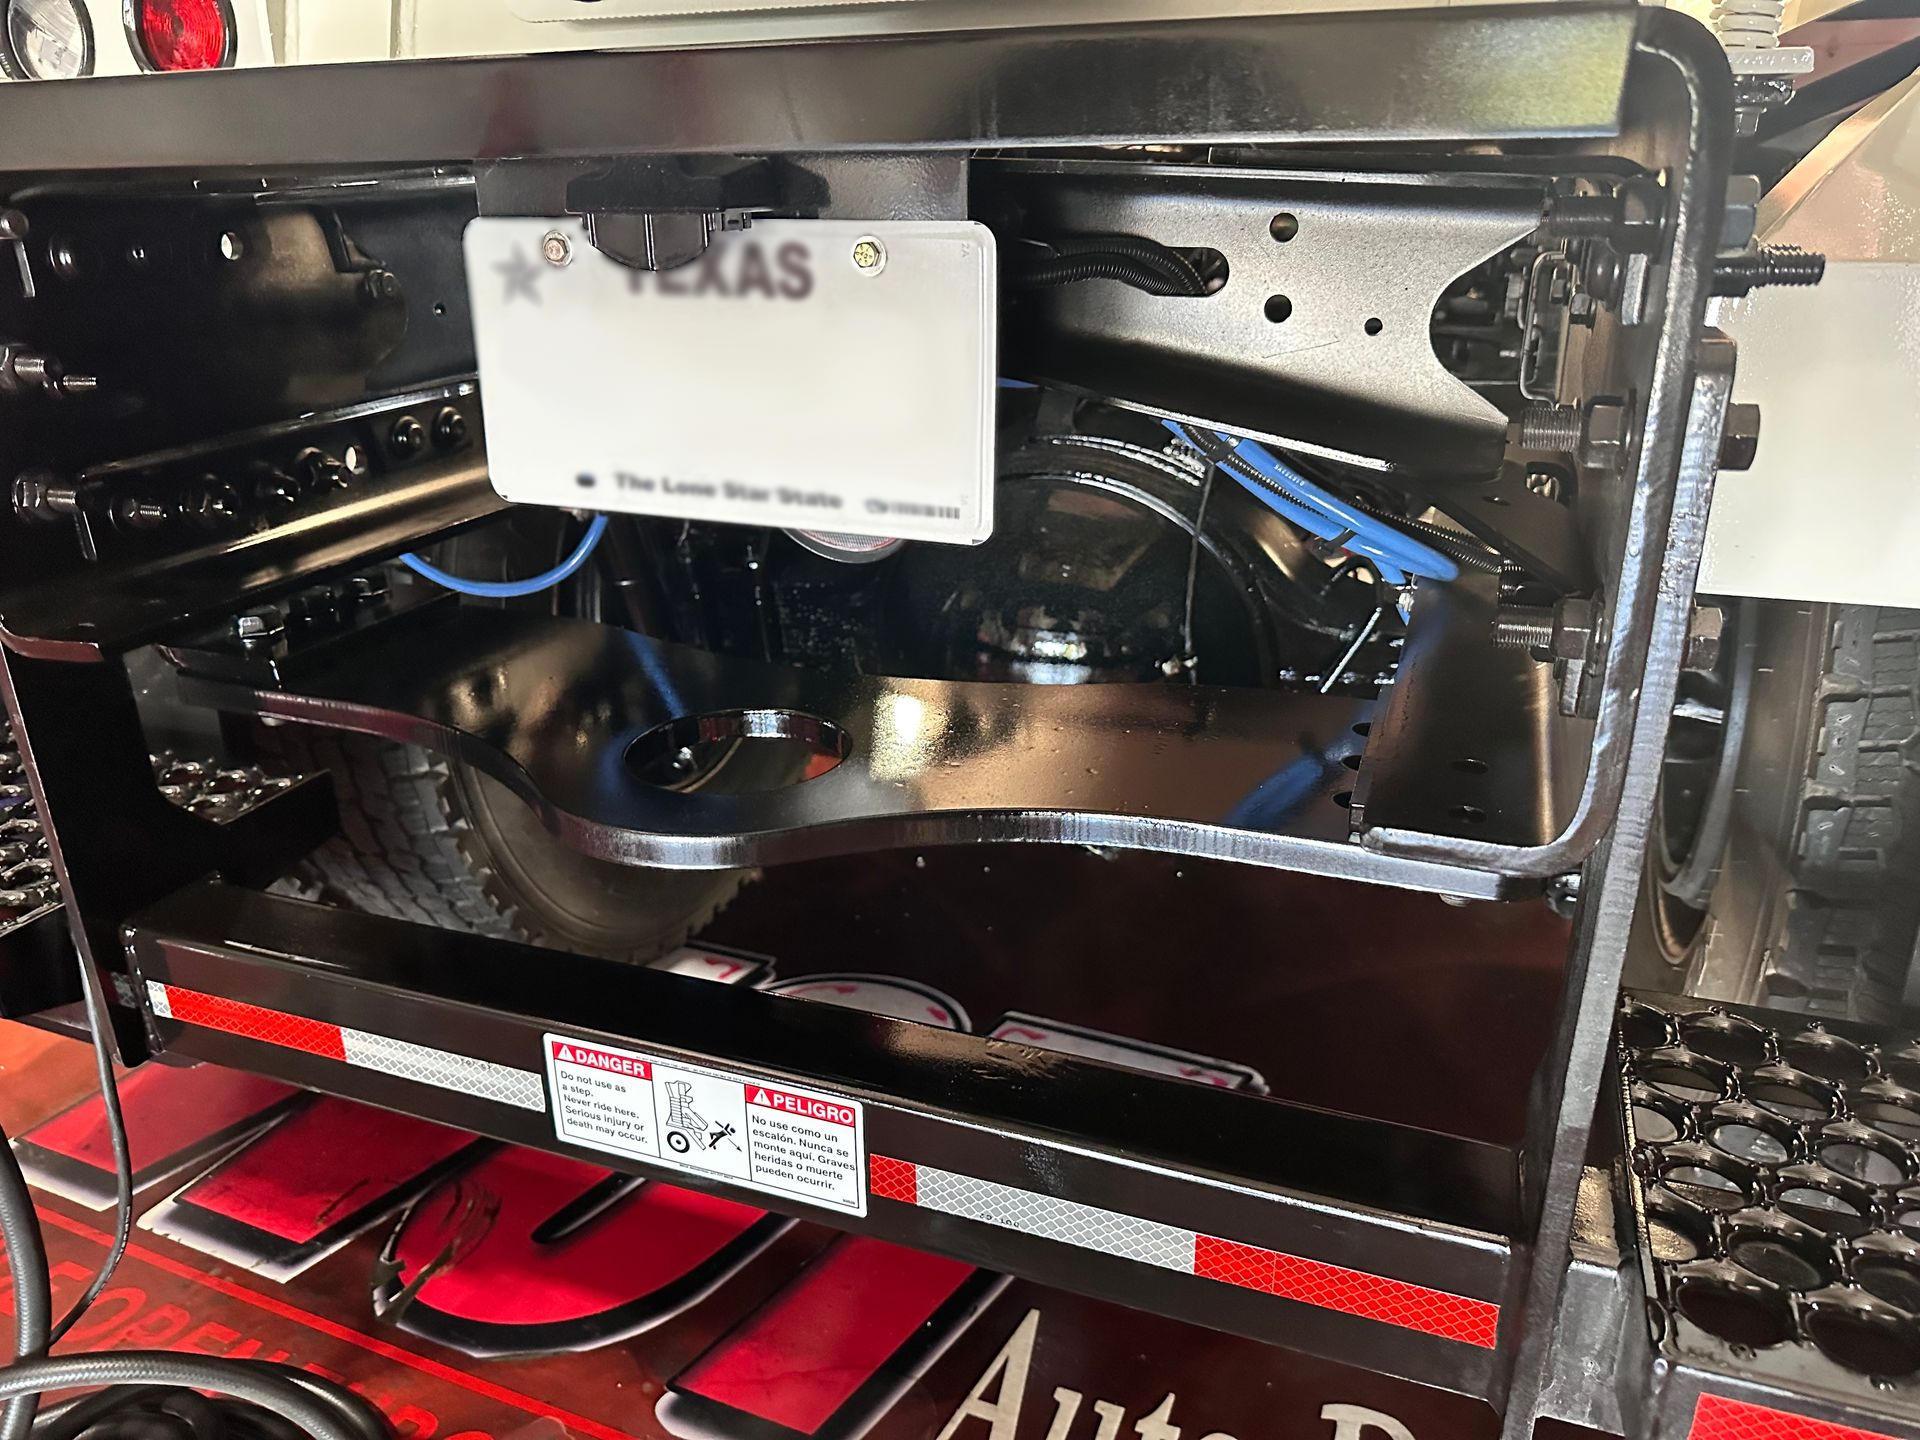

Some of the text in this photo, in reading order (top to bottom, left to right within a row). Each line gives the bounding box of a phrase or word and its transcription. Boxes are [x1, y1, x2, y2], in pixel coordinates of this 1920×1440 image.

[627, 237, 814, 300] XAS
[576, 1050, 644, 1077] DANGER
[561, 1071, 626, 1093] Do not use as
[571, 1085, 593, 1097] step.
[564, 1095, 639, 1119] Never ride here.
[566, 1106, 601, 1120] Serious
[604, 1115, 631, 1129] injury
[774, 1094, 852, 1123] PELIGRO
[567, 1118, 647, 1143] death may occur.
[752, 1115, 838, 1142] No use como un
[753, 1129, 848, 1157] escalón. Nunca se
[754, 1141, 855, 1170] monte aquí. Graves
[755, 1151, 793, 1168] heridas
[806, 1165, 843, 1180] muerte
[756, 1165, 834, 1190] pueden ocurrir.
